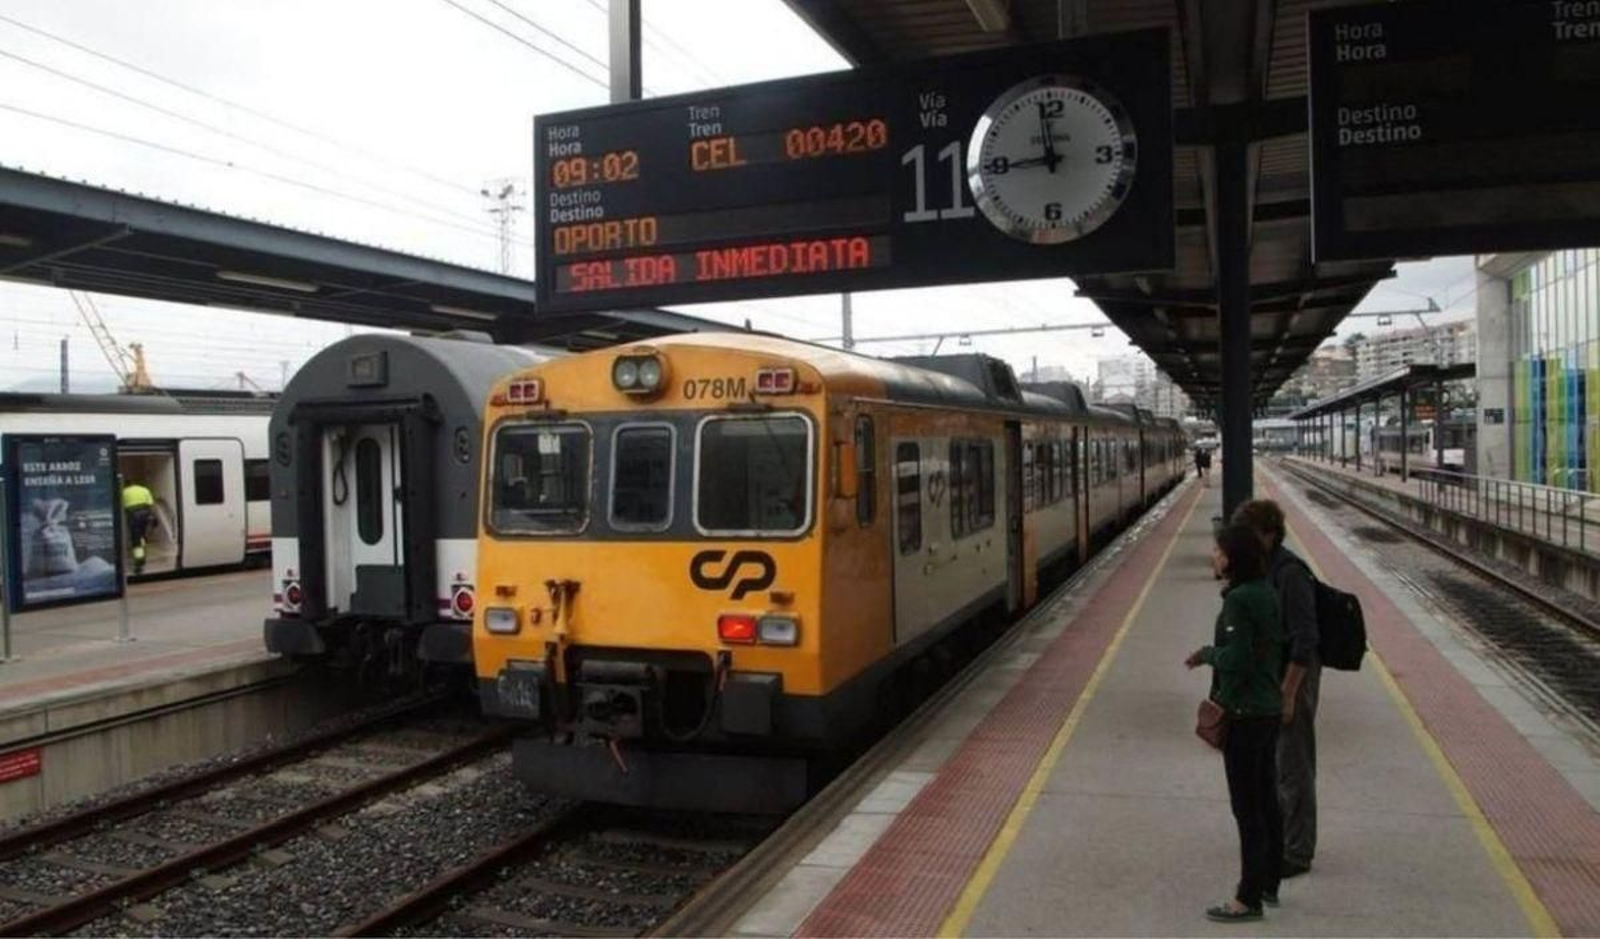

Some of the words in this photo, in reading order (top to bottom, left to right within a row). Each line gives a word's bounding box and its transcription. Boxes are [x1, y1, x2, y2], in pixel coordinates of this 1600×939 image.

[1335, 22, 1383, 41] Hora
[1336, 43, 1387, 62] Hora
[688, 104, 720, 120] Tren
[920, 109, 948, 128] Vía
[1035, 100, 1065, 119] 12
[1338, 104, 1417, 125] Destino
[548, 124, 580, 139] Hora
[688, 121, 722, 137] Tren
[1338, 125, 1422, 146] Destino
[549, 141, 582, 157] Hora
[691, 137, 747, 171] CEL
[785, 119, 888, 159] 00420
[1095, 145, 1113, 165] 3
[553, 151, 640, 188] 09:02
[990, 156, 1010, 175] 9
[901, 141, 976, 223] 11
[550, 189, 601, 207] Destino
[550, 205, 604, 223] Destino
[1044, 202, 1062, 222] 6
[554, 217, 658, 254] OPORTO
[570, 255, 676, 291] SALIDA
[695, 238, 869, 281] INMEDIATA
[683, 378, 746, 400] 078M
[65, 475, 73, 485] A
